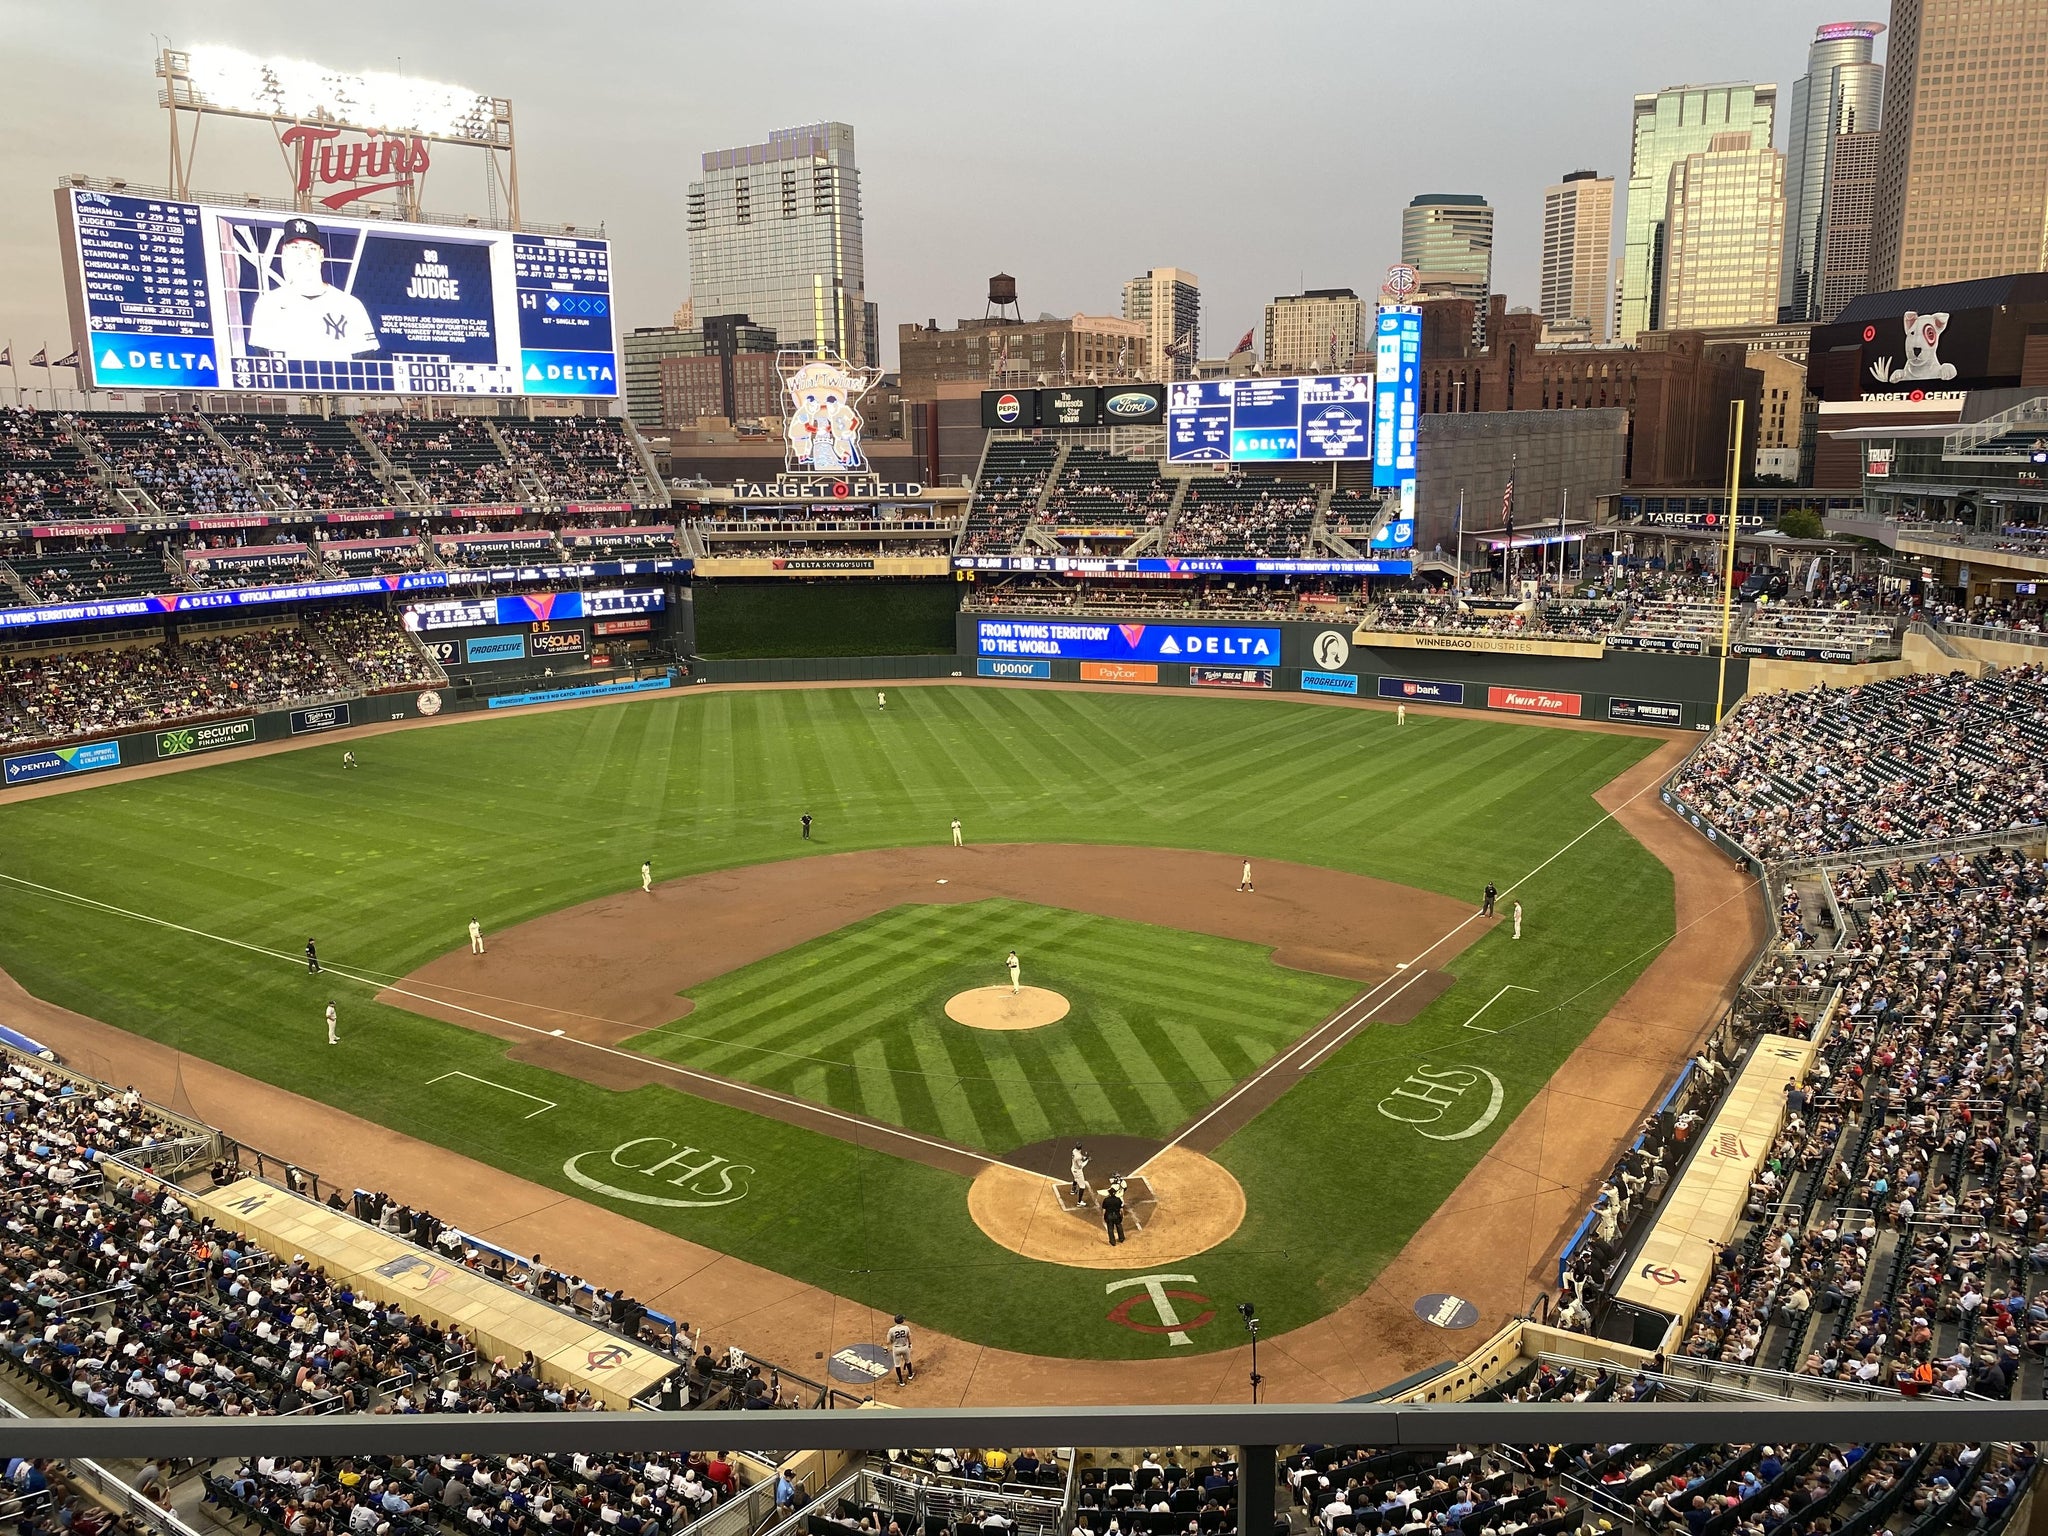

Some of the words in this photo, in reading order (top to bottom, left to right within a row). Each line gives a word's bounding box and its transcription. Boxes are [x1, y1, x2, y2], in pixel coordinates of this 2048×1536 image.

[281, 126, 430, 192] Twins
[78, 205, 113, 216] GRISHAM
[79, 217, 105, 226] JUDGE
[81, 228, 98, 236] RICE
[82, 239, 123, 249] BELLINGER
[83, 249, 118, 259] STANTON
[140, 254, 151, 262] DH
[85, 260, 119, 270] CHISHOLM
[415, 263, 449, 278] AARON
[86, 271, 125, 281] MCMAHON
[88, 282, 112, 290] VOLPE
[157, 287, 171, 295] .207
[407, 277, 460, 300] JUDGE
[89, 292, 114, 301] WELLS
[521, 293, 537, 310] 1-1
[129, 351, 215, 371] DELTA
[547, 365, 613, 381] DELTA
[790, 375, 818, 392] Win!
[821, 374, 867, 391] Twins!
[1061, 392, 1071, 400] The
[1861, 392, 1910, 401] TARGET
[1924, 390, 1968, 400] CENTE
[1054, 400, 1084, 408] Minnesota
[1117, 397, 1148, 412] Ford
[1067, 407, 1080, 415] Star
[1059, 414, 1080, 423] Tribune
[1250, 438, 1297, 450] DELTA
[733, 483, 830, 498] TARGET
[854, 482, 923, 498] FIELD
[460, 509, 493, 517] Treasure
[1648, 513, 1700, 524] TARGET
[198, 519, 234, 529] Treasure
[236, 518, 262, 527] Island
[464, 542, 508, 552] Treasure
[510, 539, 541, 549] Island
[595, 536, 622, 546] Home
[624, 535, 642, 545] Run
[643, 533, 666, 544] Deck
[267, 555, 300, 567] Island
[343, 550, 372, 561] Home
[1191, 561, 1223, 570] DELTA
[1255, 563, 1273, 571] FROM
[1273, 563, 1294, 571] TWINS
[1294, 563, 1330, 571] TERRITORY
[1331, 563, 1340, 571] TO
[1340, 563, 1354, 571] THE
[1354, 563, 1380, 571] WORLD.
[413, 576, 445, 588] DELTA
[192, 594, 232, 607] DELTA
[239, 591, 269, 603] OFFICIAL
[271, 589, 299, 600] AIRLINE
[300, 588, 309, 597] OF
[309, 587, 322, 596] THE
[322, 583, 359, 596] MINNESOTA
[359, 581, 382, 592] TWINS.
[6, 612, 36, 625] TWINS
[37, 609, 85, 621] TERRITORY
[86, 608, 97, 617] TO
[99, 606, 114, 616] THE
[114, 602, 149, 615] WORLD.
[533, 622, 551, 633] 0:15
[980, 623, 1012, 638] FROM
[1015, 624, 1049, 639] TWINS
[1050, 625, 1110, 641] TERRITORY
[469, 642, 521, 655] PROGRESSIVE
[980, 639, 996, 651] TO
[997, 640, 1021, 652] THE
[1022, 640, 1061, 654] WORLD.
[1186, 636, 1270, 655] DELTA
[1415, 638, 1472, 650] WINNEBAGO
[1472, 641, 1532, 652] INDUSTRIES
[1607, 637, 1633, 647] Corona
[1639, 638, 1665, 649] Corona
[1671, 640, 1699, 651] Corona
[1733, 644, 1762, 655] Corona
[1776, 646, 1806, 658] Corona
[1819, 649, 1850, 660] Corona
[993, 662, 1034, 675] uponor
[1100, 667, 1137, 680] Paycor
[1242, 671, 1257, 683] ONE
[1303, 676, 1355, 689] PROGRESSIVE
[1416, 684, 1440, 696] bank
[391, 712, 404, 720] 377
[1638, 706, 1661, 715] POWERED
[197, 722, 249, 740] securian
[1695, 723, 1710, 731] 328
[198, 736, 236, 748] FINANCIAL
[21, 759, 61, 772] PENTAIR
[1377, 1064, 1477, 1123] CHS
[1711, 1132, 1740, 1162] Twins
[610, 1138, 755, 1196] CHS
[592, 1301, 600, 1312] 78
[894, 1329, 906, 1339] 22
